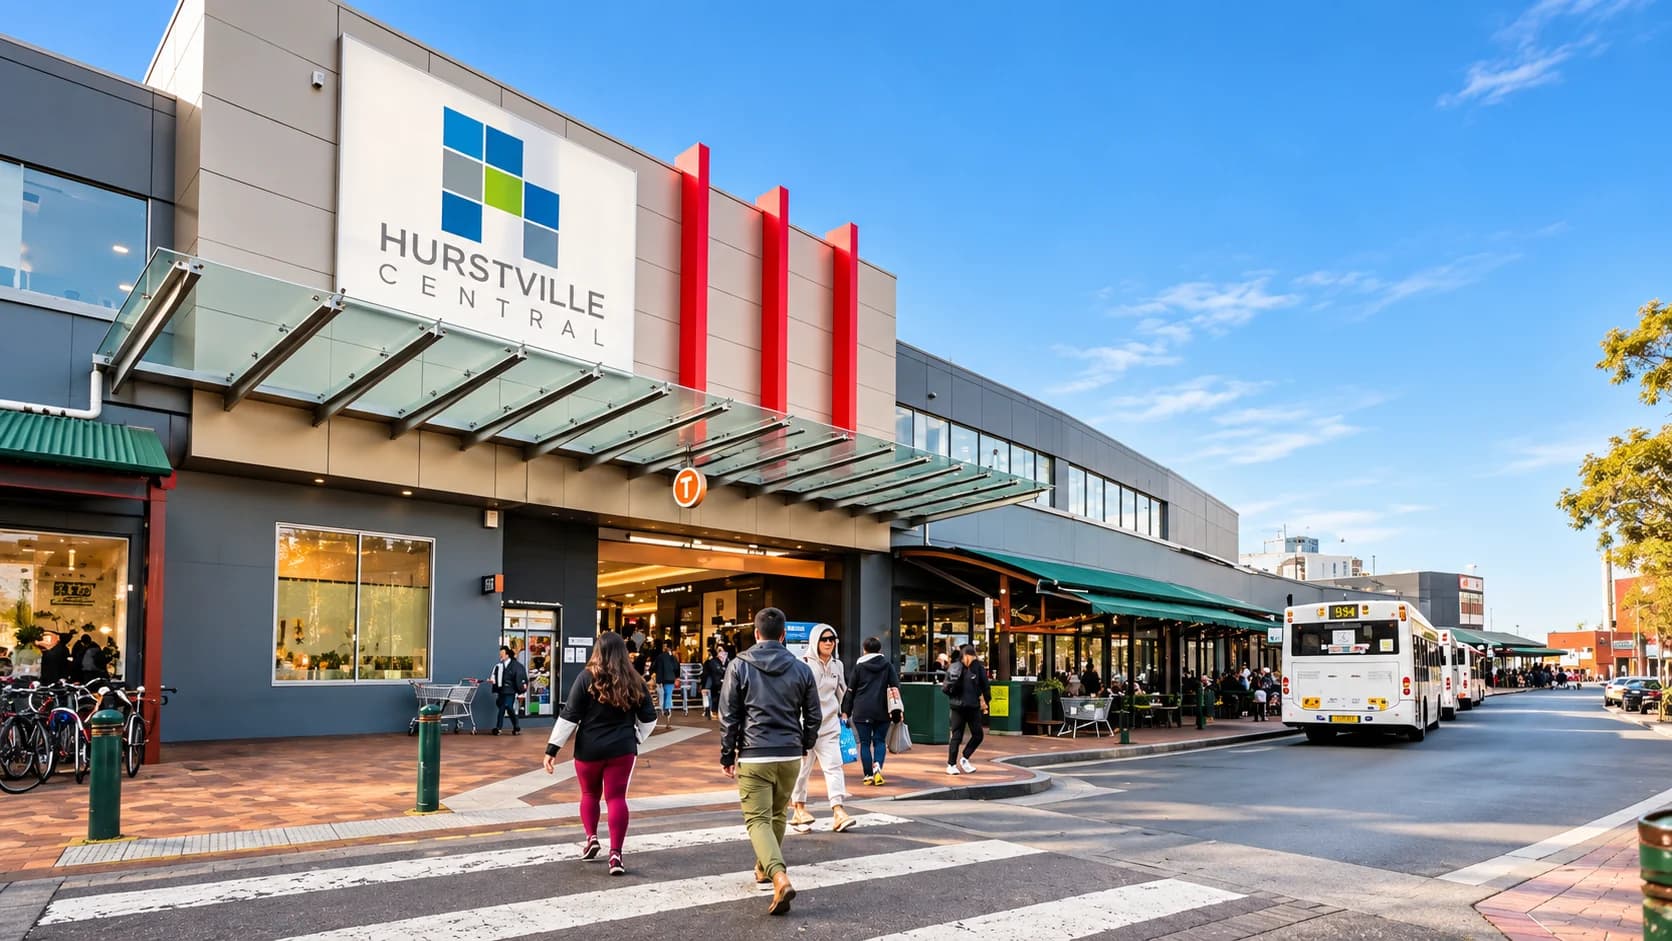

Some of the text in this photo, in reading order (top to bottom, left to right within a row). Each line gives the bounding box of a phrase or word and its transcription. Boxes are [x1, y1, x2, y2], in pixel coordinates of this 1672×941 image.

[378, 263, 604, 347] CENTRAL
[380, 222, 605, 319] HURSTVILLE
[680, 476, 692, 498] T
